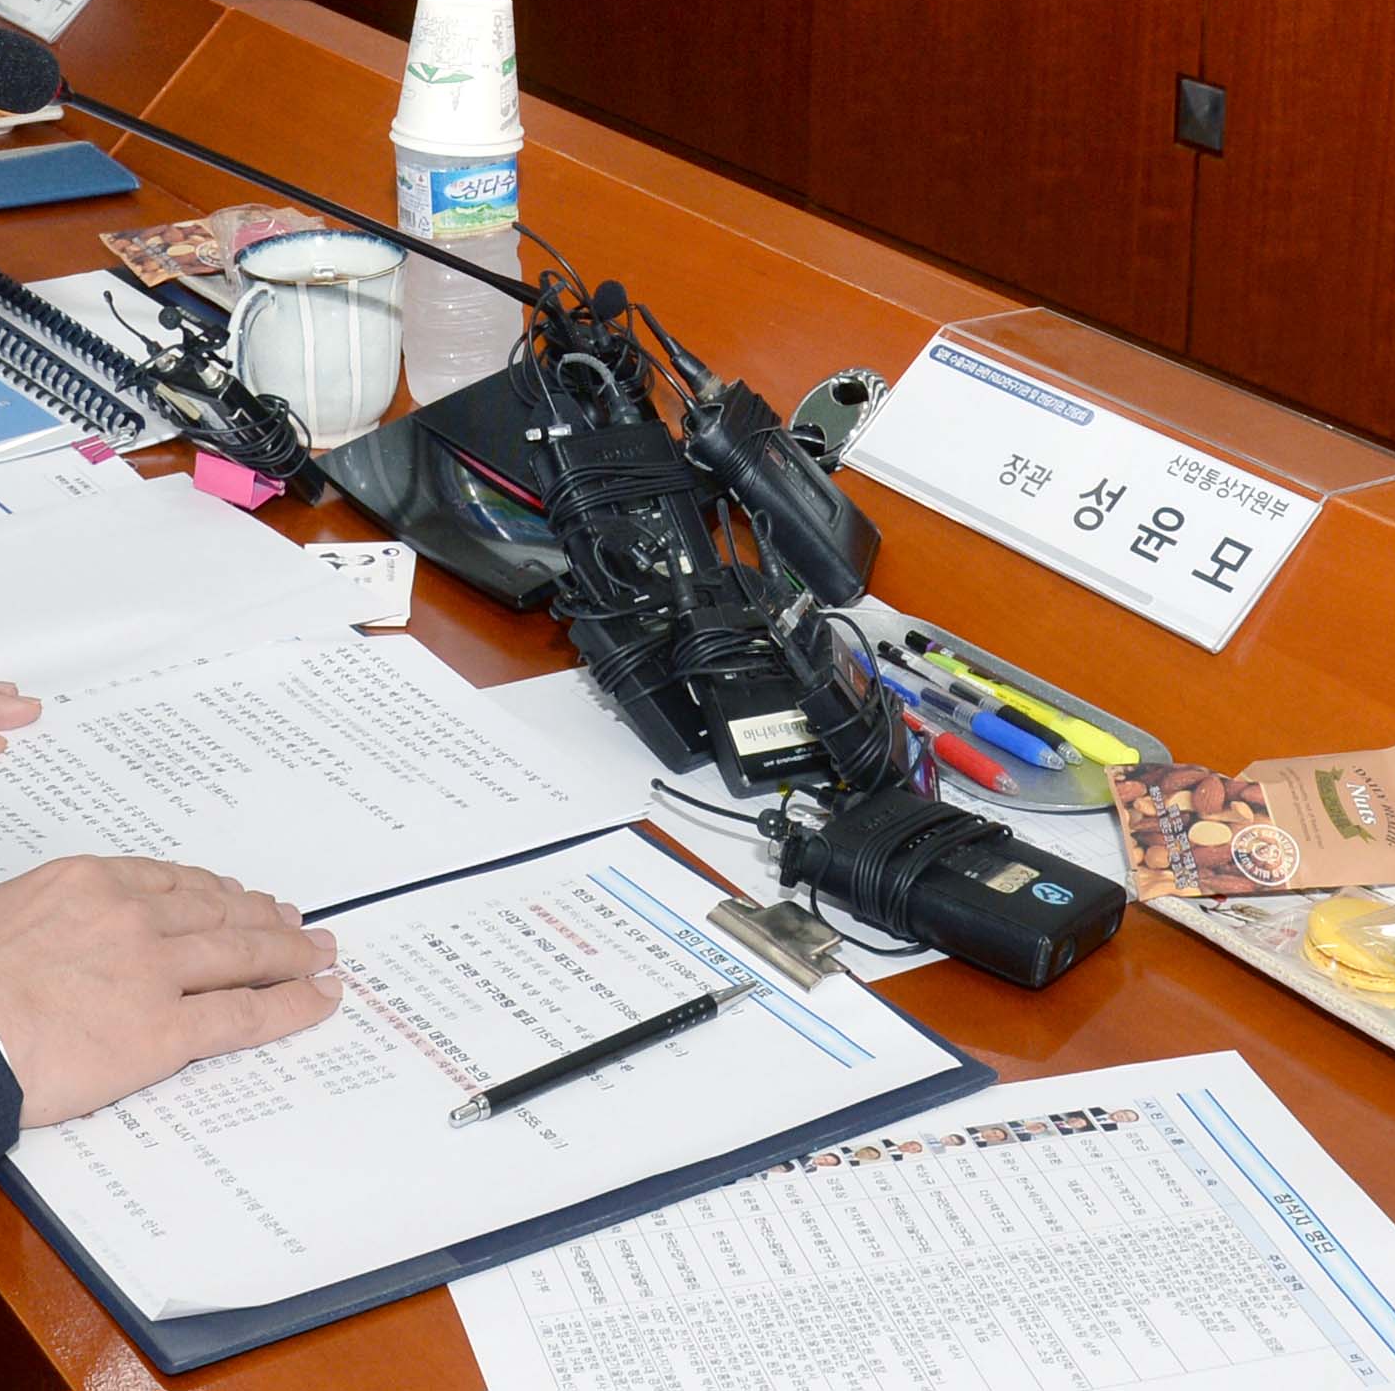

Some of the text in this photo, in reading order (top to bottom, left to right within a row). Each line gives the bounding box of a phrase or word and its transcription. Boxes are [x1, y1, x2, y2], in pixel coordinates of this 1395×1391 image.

[459, 170, 516, 200] 삼다수
[997, 451, 1054, 499] 장관
[1167, 453, 1291, 522] 산업통상자원부
[1346, 781, 1377, 825] Nuts
[567, 887, 599, 904] 회의
[416, 932, 464, 962] 수출규제
[493, 908, 540, 937] 산업기술
[547, 952, 598, 983] 제도개선
[586, 982, 618, 1000] 방안
[671, 928, 707, 947] 회의
[695, 946, 732, 965] 진행
[1269, 1191, 1340, 1256] 참석자 명단
